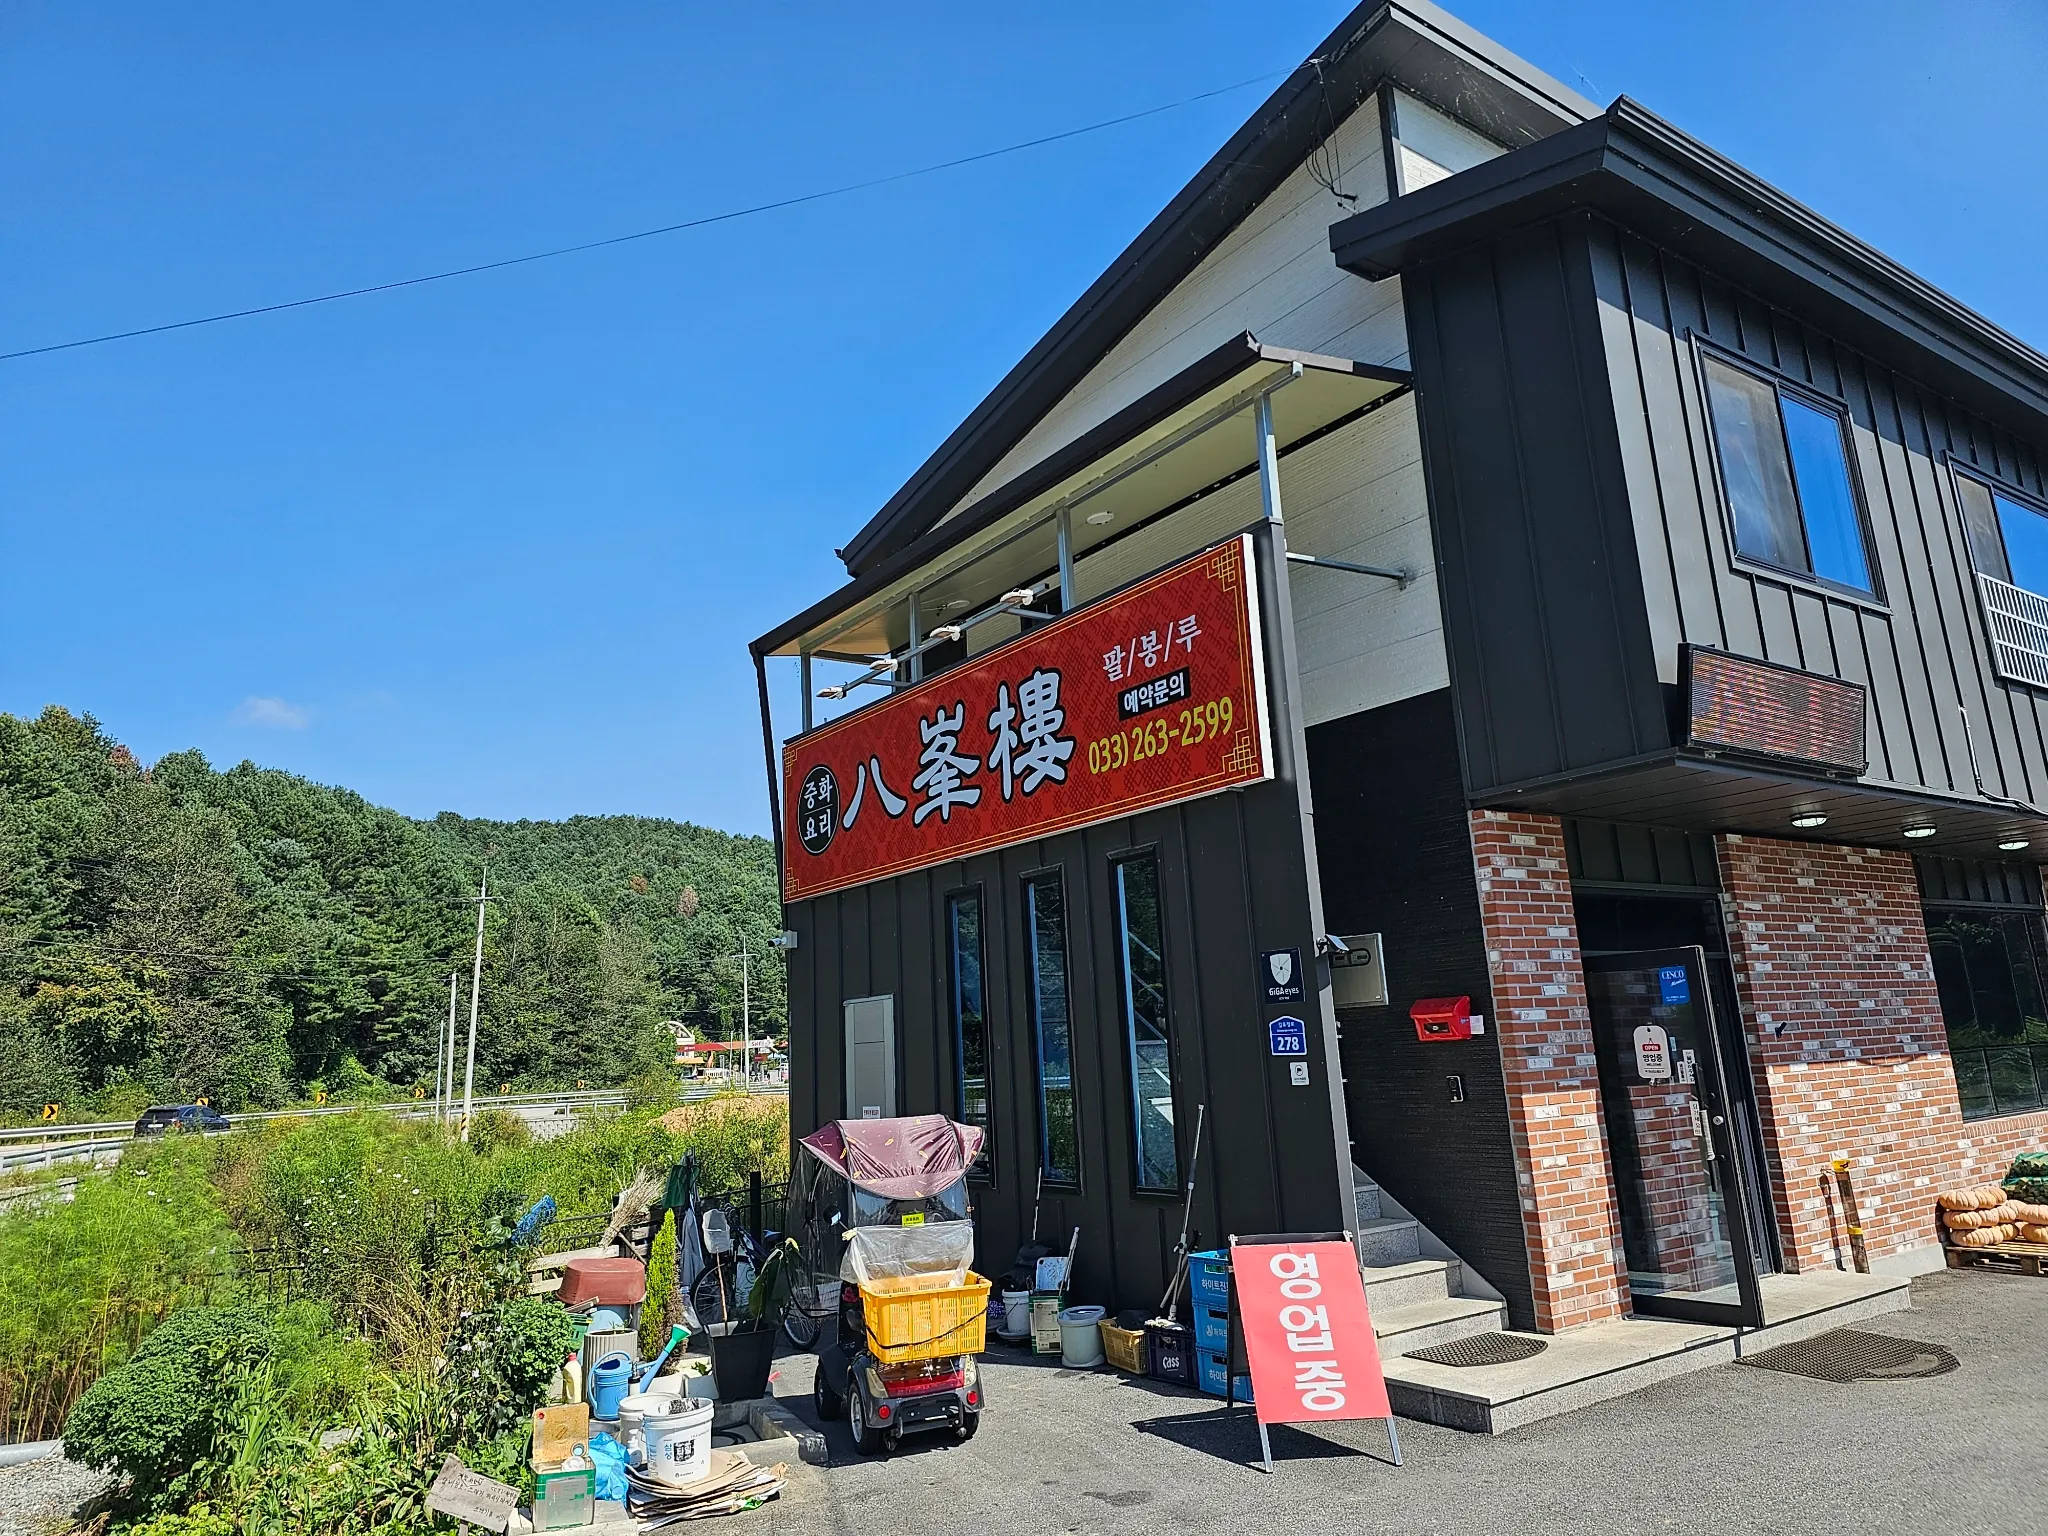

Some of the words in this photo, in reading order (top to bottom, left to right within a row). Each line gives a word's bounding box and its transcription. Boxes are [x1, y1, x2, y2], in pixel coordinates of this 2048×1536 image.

[1103, 614, 1202, 682] 팔/봉/루
[1123, 672, 1185, 713] 예약문의
[803, 774, 833, 810] 중화
[803, 808, 832, 841] 요리
[1661, 969, 1685, 980] CESCO
[1277, 1036, 1300, 1051] 278
[1642, 1053, 1663, 1063] 영업중
[1269, 1252, 1347, 1412] 영업중
[1162, 1355, 1180, 1370] Cass
